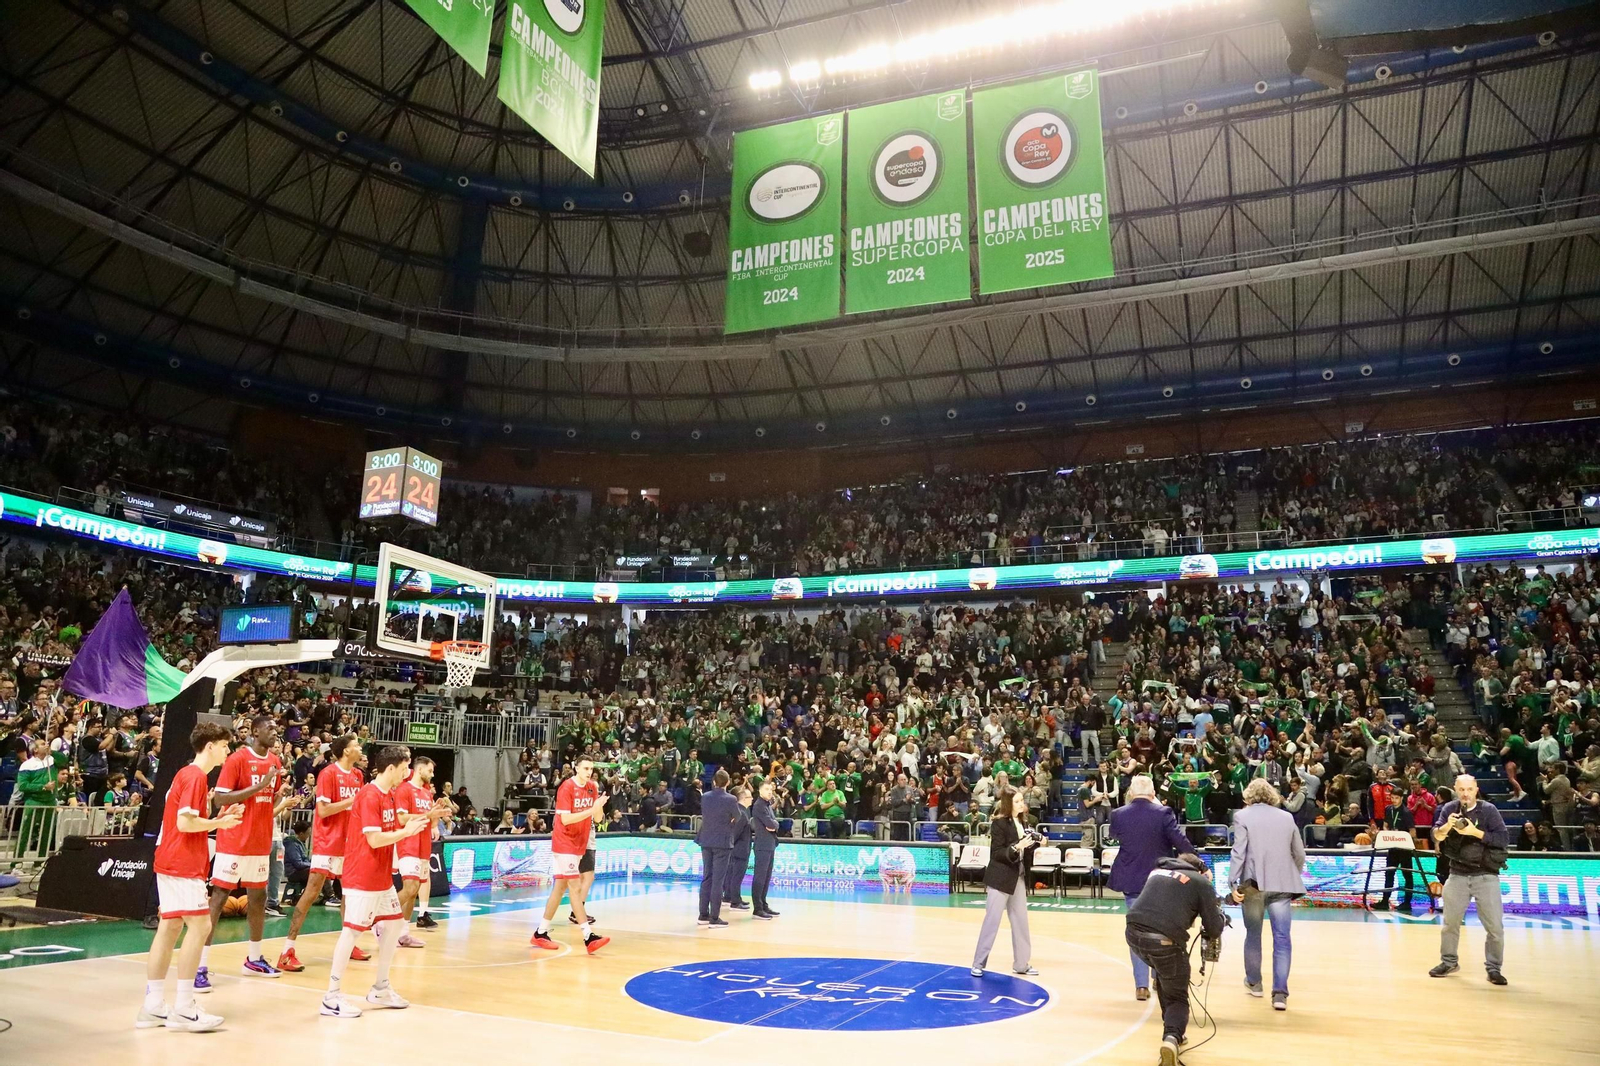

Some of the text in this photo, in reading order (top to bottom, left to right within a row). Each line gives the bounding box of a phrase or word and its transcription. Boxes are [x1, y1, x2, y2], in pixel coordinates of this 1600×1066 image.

[511, 3, 596, 105] CAMPEONES
[541, 68, 563, 101] BCL
[1022, 143, 1047, 153] Copa
[1034, 149, 1050, 158] Rey
[886, 160, 924, 171] supercopa
[889, 165, 924, 177] endesa
[984, 193, 1103, 234] CAMPEONES
[851, 213, 962, 252] CAMPEONES
[985, 218, 1103, 247] COPA DEL REY
[731, 234, 834, 273] CAMPEONES
[852, 237, 964, 267] SUPERCOPA
[1025, 249, 1065, 269] 2025
[732, 259, 833, 281] FIBA INTERCONTINENTAL
[773, 273, 789, 282] CUP
[887, 266, 925, 285] 2024
[763, 286, 799, 305] 2024
[371, 453, 400, 470] 3:00
[412, 455, 437, 477] 3:00
[365, 472, 397, 503] 24
[407, 475, 434, 510] 24
[127, 496, 155, 509] Unicaja
[186, 508, 212, 521] Unicaja
[36, 507, 166, 550] ¡Campeón!
[240, 520, 265, 532] Unicaja
[1528, 540, 1563, 551] Copa
[1554, 548, 1582, 556] Canaria
[1248, 544, 1383, 575] ¡Campeón!
[828, 572, 937, 596] ¡Campeón!
[27, 651, 71, 665] UNICAJA
[574, 797, 594, 809] BAXI
[1382, 835, 1407, 843] Wilson
[111, 868, 136, 881] Unicaja
[113, 860, 148, 870] Fundación
[773, 859, 867, 880] opa del Rey
[773, 877, 795, 886] Gran
[796, 878, 833, 888] Canaria
